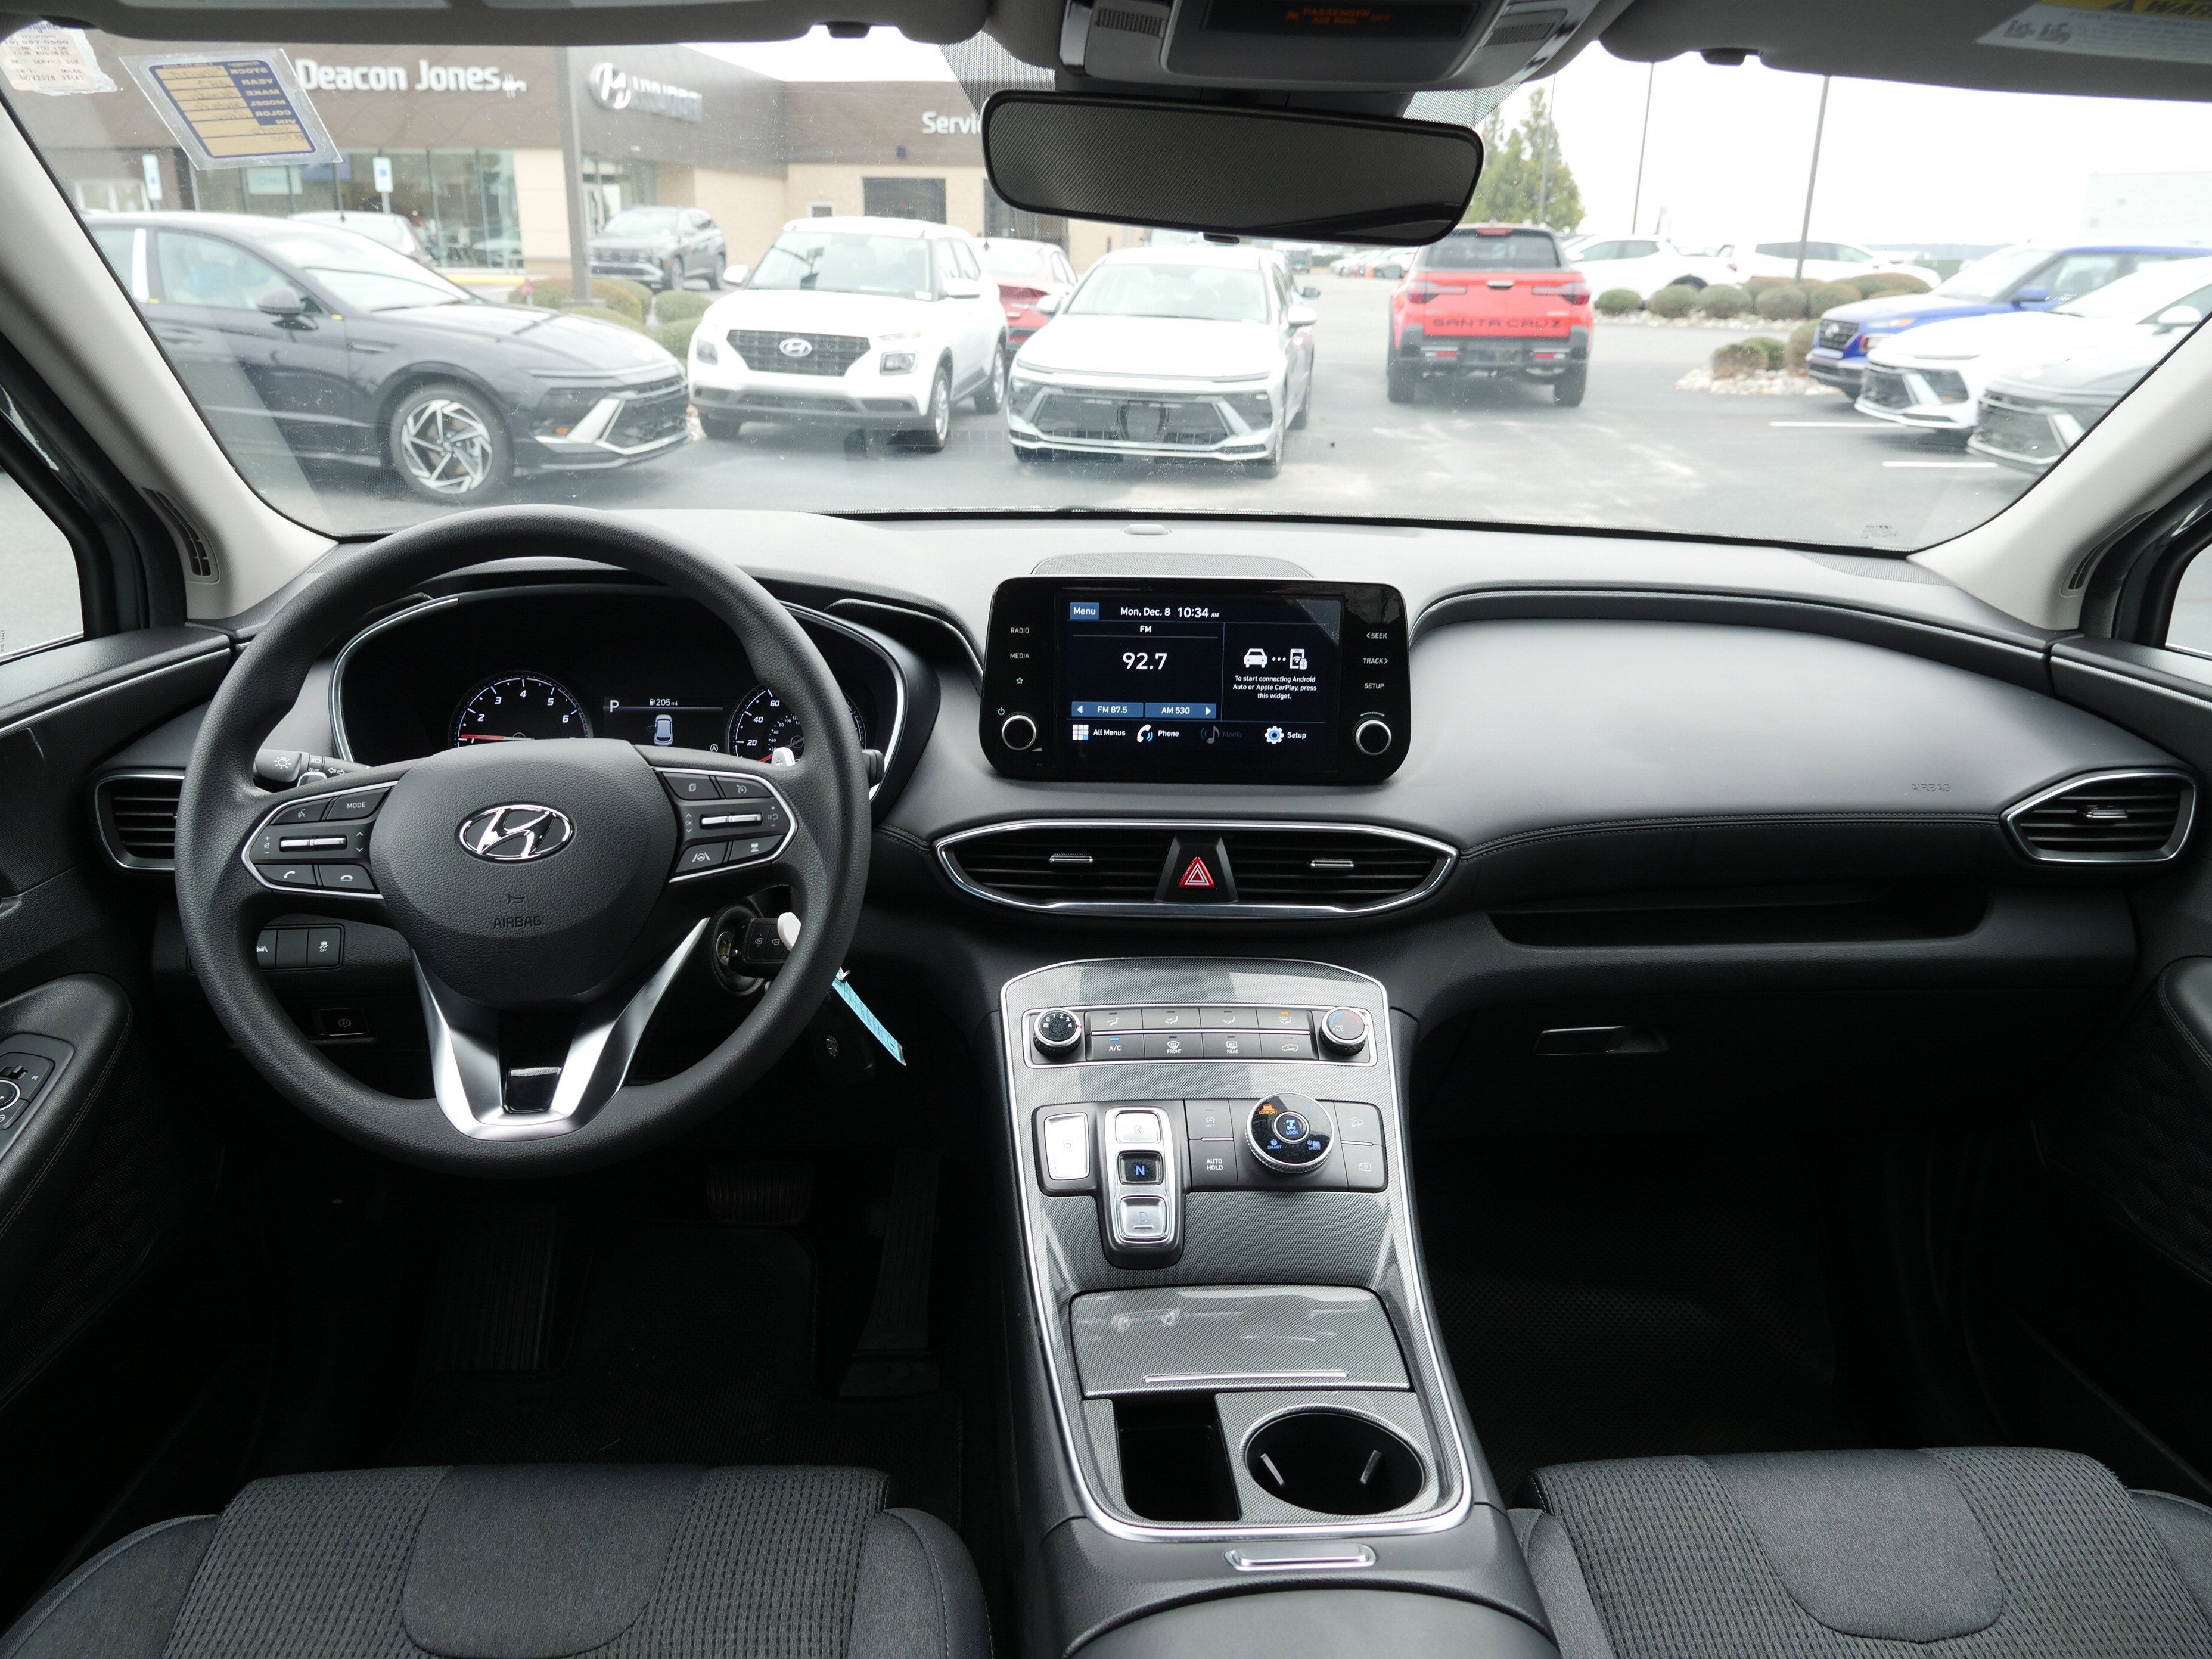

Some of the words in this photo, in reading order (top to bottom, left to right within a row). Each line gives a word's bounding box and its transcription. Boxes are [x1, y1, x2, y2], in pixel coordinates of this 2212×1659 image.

[1303, 8, 1370, 16] PASSENGER
[296, 59, 408, 91] Deacon
[415, 59, 502, 91] Jones
[1433, 319, 1501, 328] SANTA
[1120, 607, 1141, 616] Mon,
[1144, 608, 1163, 616] Dec.
[1164, 608, 1171, 616] 8
[1178, 608, 1209, 618] 10:34
[1123, 653, 1168, 670] 92.7
[520, 690, 527, 698] 4
[610, 700, 619, 713] P
[1912, 783, 1952, 792] AIRBAG
[493, 915, 542, 928] AIRBAG
[1134, 1125, 1142, 1133] R
[1064, 1142, 1071, 1151] P
[1136, 1165, 1145, 1175] N
[1138, 1211, 1147, 1222] D
